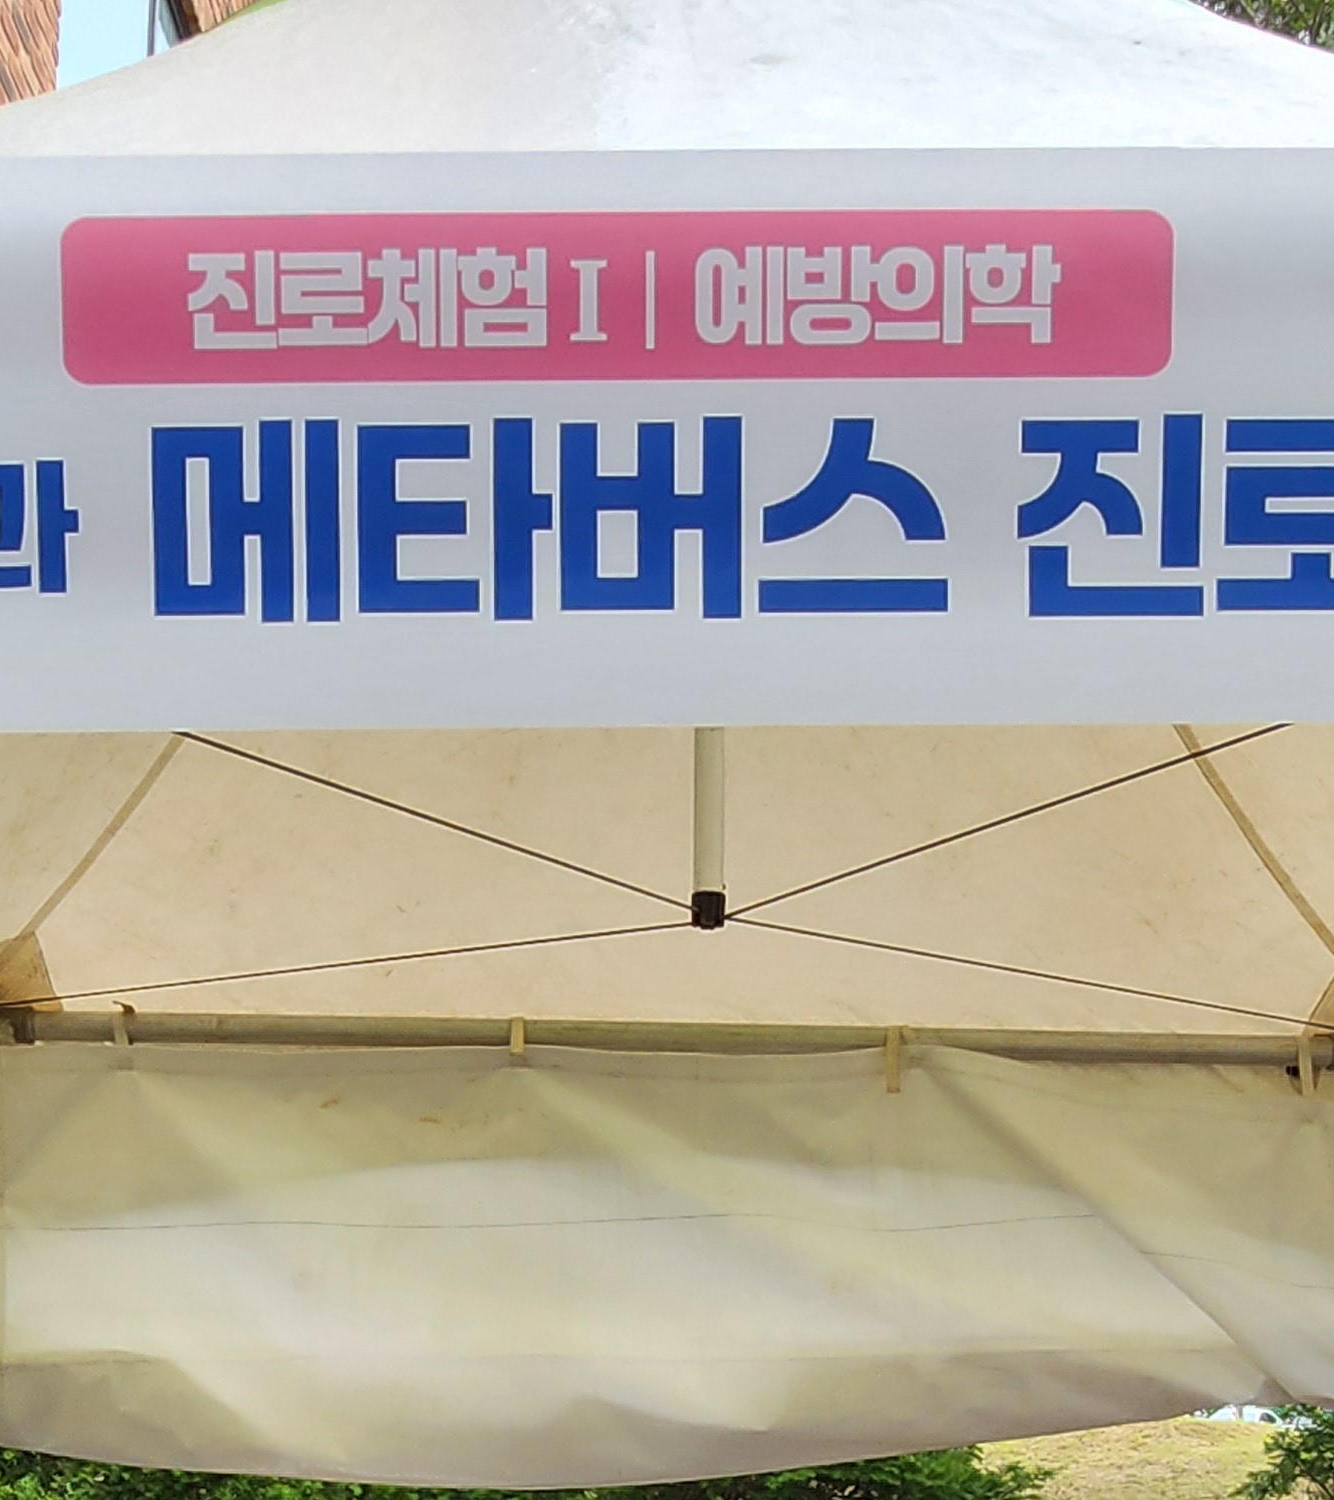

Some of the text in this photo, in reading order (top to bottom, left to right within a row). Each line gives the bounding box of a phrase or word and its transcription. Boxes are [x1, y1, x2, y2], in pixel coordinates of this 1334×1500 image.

[187, 247, 548, 349] 진로체험
[693, 244, 1062, 346] 예방의학
[152, 415, 949, 624] 메타버스
